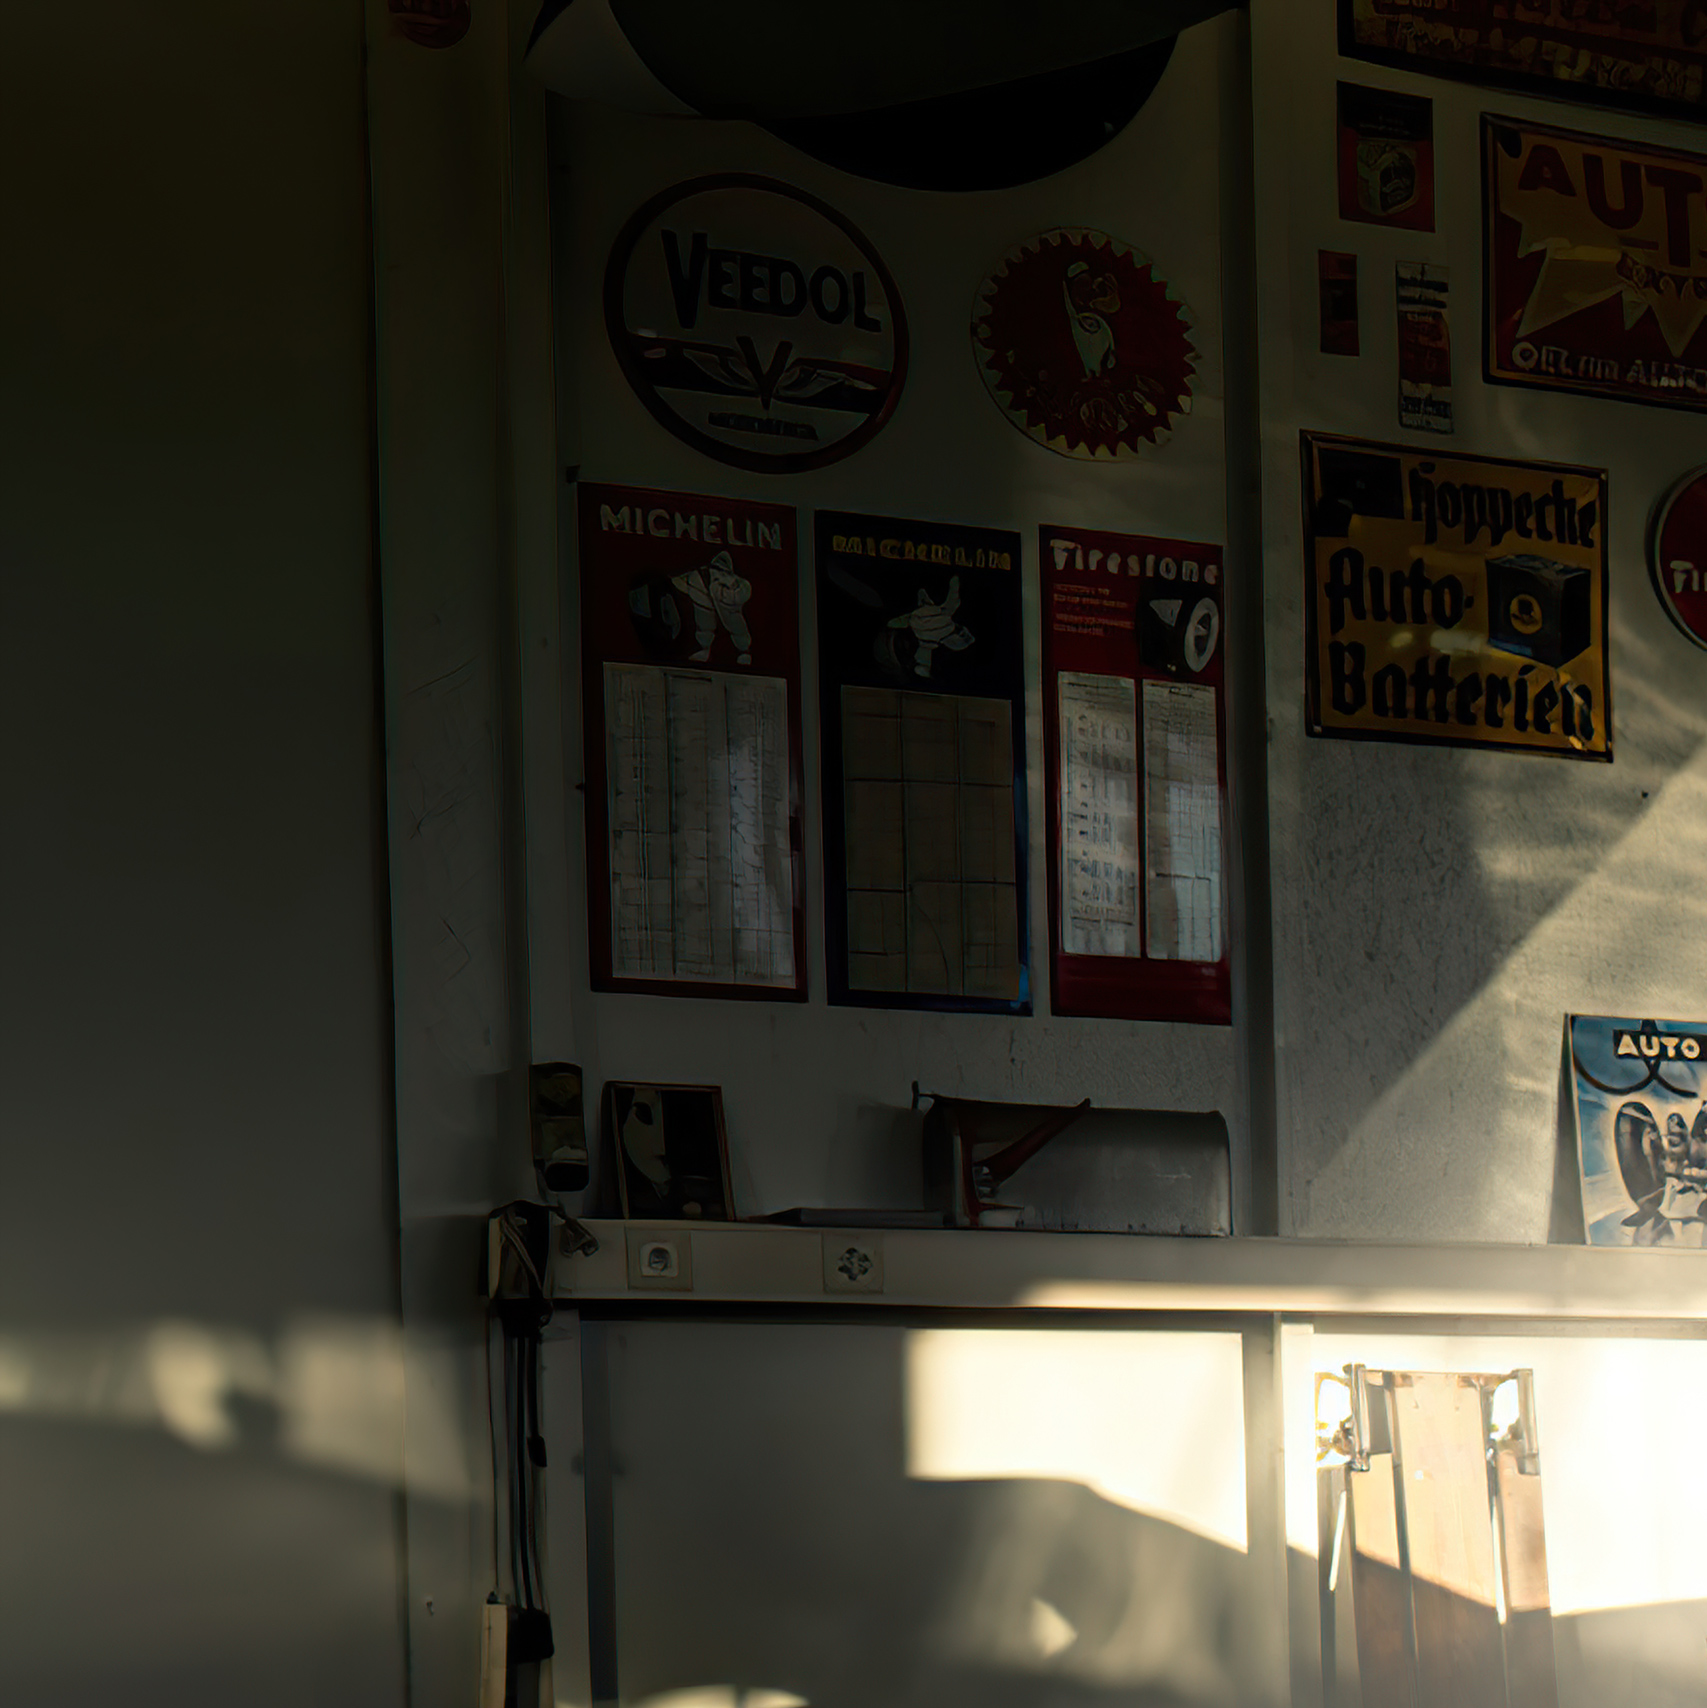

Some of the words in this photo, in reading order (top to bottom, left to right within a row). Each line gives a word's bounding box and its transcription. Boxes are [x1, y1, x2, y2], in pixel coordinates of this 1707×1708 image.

[661, 228, 881, 332] VEEDOL
[600, 503, 783, 551] MICHELIN
[832, 535, 1011, 571] MICHELIN
[1050, 538, 1220, 586] Firestone
[1325, 547, 1474, 635] Auto-
[1328, 641, 1594, 741] Batterien
[1617, 1033, 1700, 1060] AUTO
